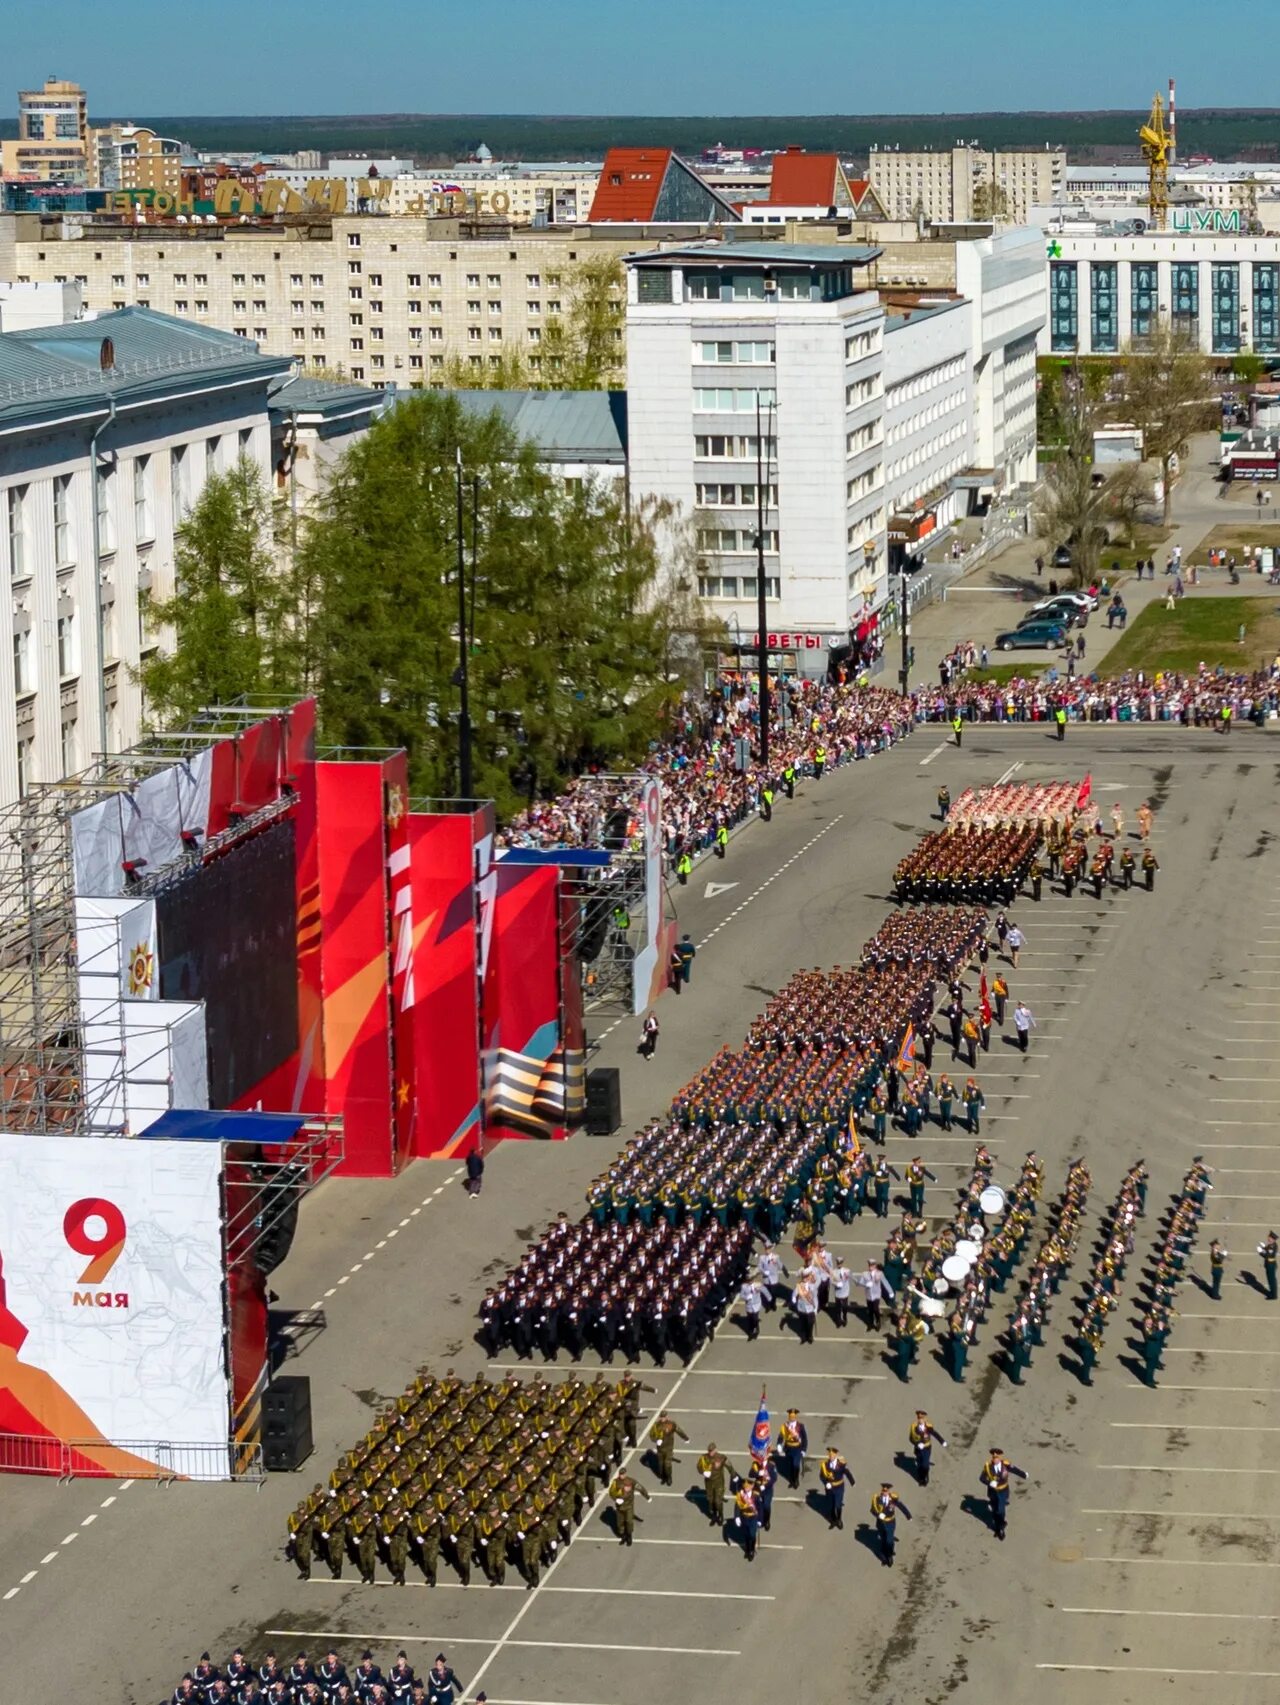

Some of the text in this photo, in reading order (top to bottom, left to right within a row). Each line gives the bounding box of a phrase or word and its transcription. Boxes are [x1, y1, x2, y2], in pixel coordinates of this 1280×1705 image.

[1172, 209, 1239, 232] ЦУМ
[63, 1197, 126, 1284] 9
[73, 1291, 129, 1308] мая
